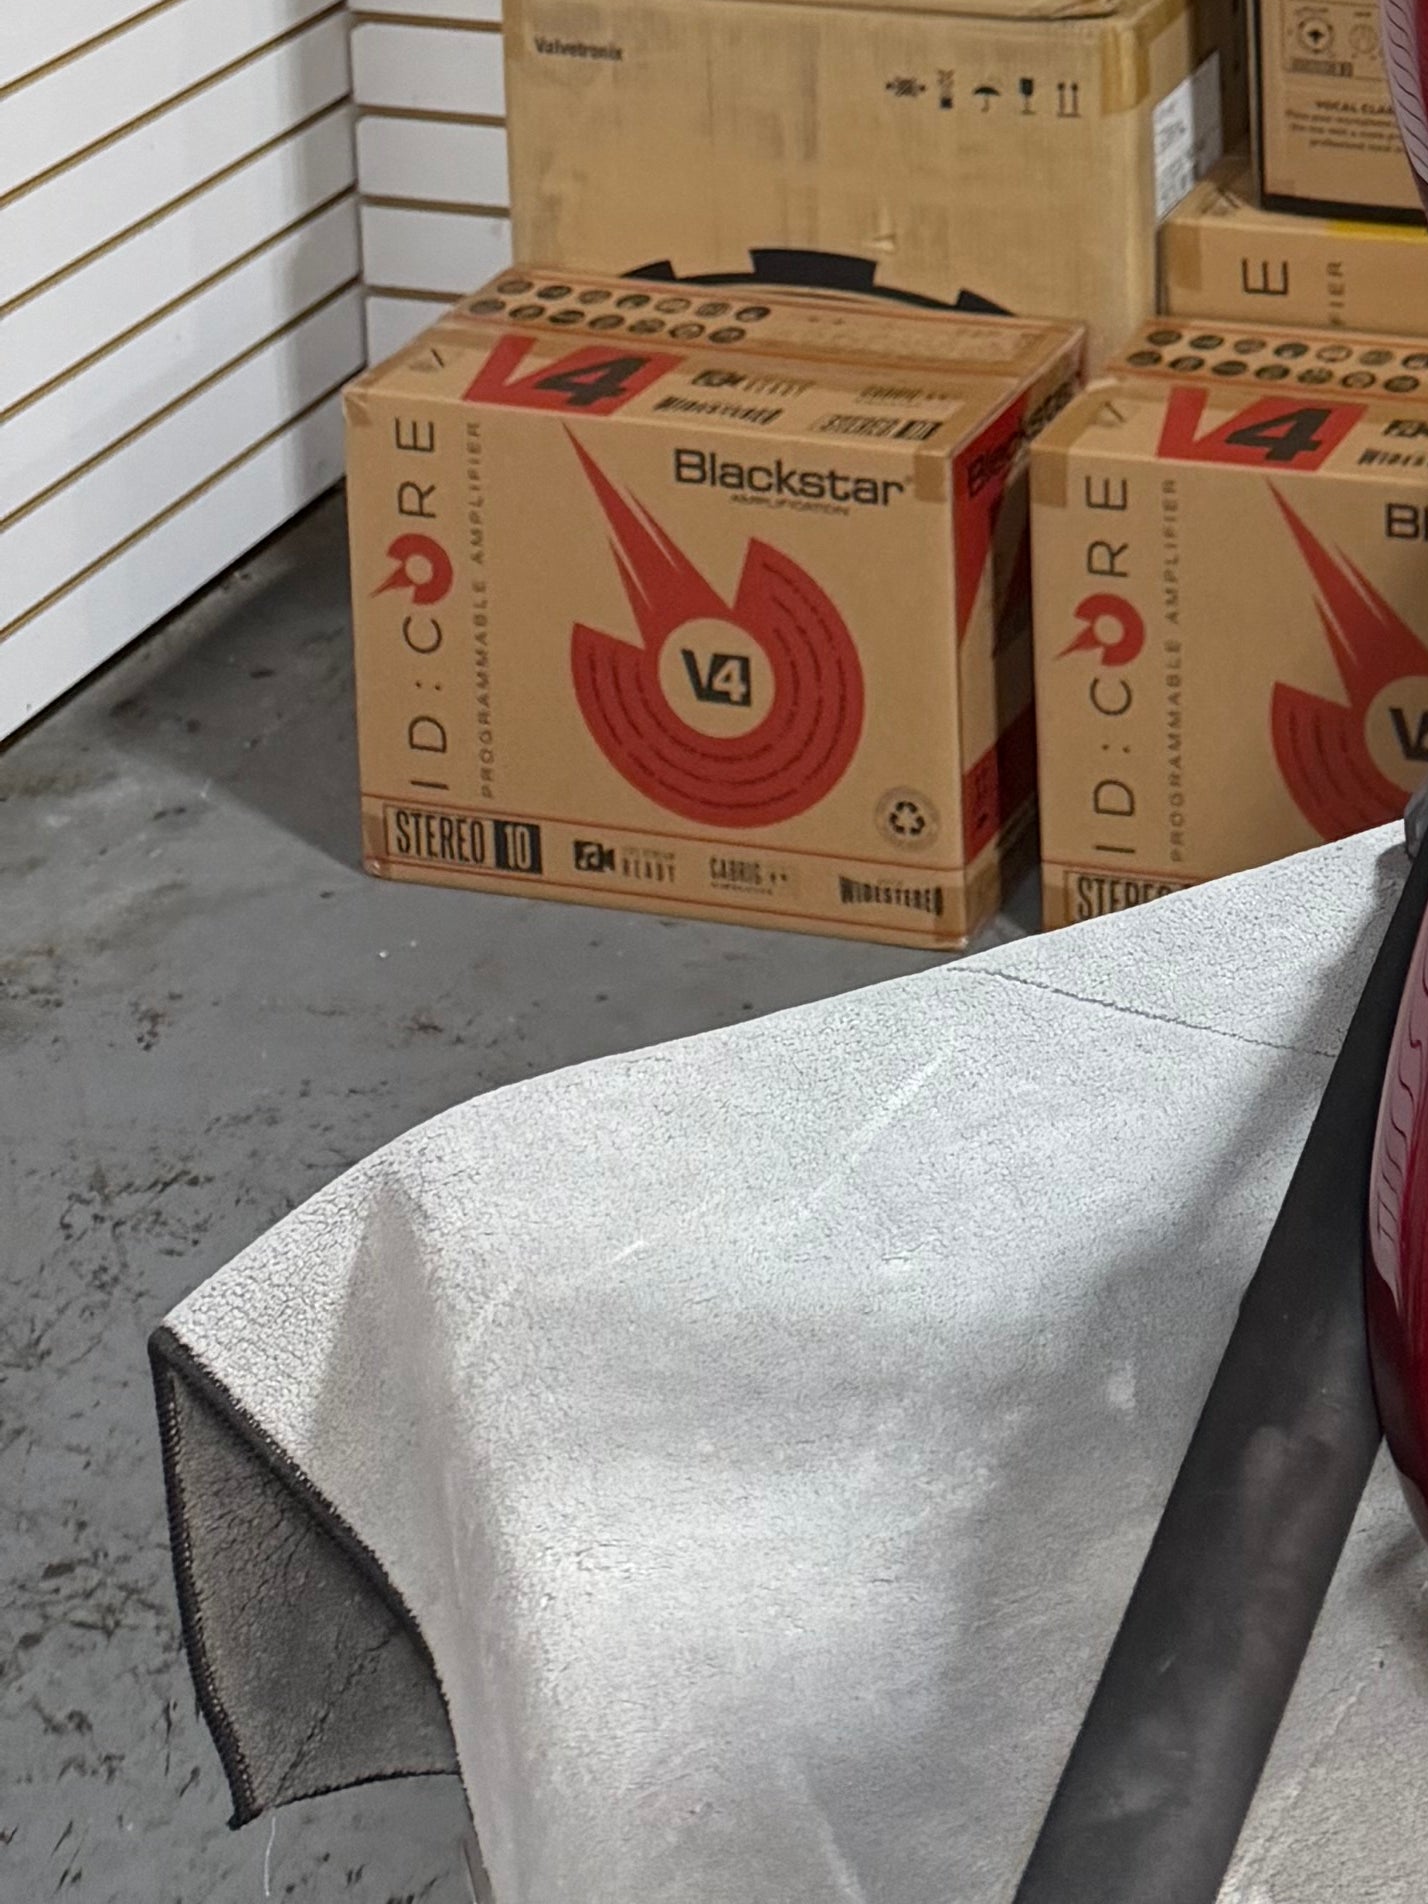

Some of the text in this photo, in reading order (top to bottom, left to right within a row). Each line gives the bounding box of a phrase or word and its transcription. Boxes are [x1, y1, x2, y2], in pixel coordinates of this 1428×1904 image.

[534, 35, 623, 62] Valvetronix
[461, 334, 687, 417] V4
[1156, 386, 1370, 472] V4
[672, 446, 905, 507] Blackstar
[729, 492, 851, 518] AMPLIFICATION
[465, 421, 497, 801] PROGRAMMABLE AMPLIFIER
[680, 647, 752, 708] V4
[1160, 477, 1184, 863] PROGRAMMABLE AMPLIFIER
[395, 810, 534, 872] STEREO 10
[622, 858, 677, 884] READY
[1075, 874, 1177, 926] STERE
